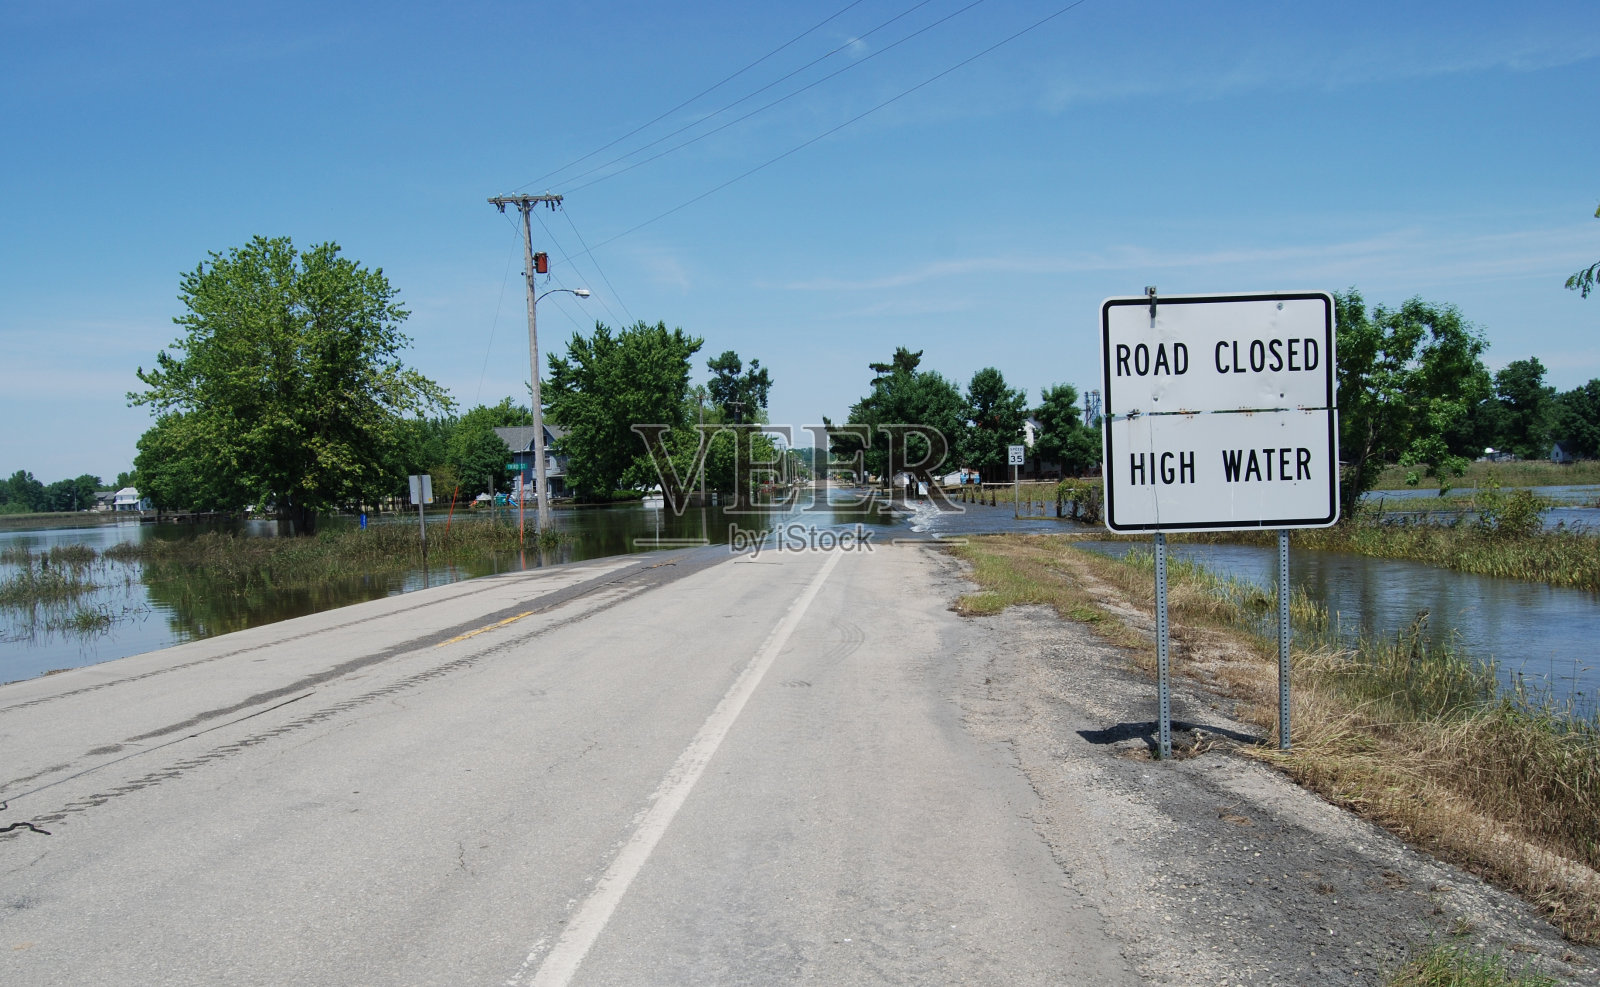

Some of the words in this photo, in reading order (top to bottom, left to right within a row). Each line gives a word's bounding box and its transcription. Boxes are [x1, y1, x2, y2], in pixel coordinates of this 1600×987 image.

[1116, 342, 1189, 377] ROAD
[1214, 338, 1319, 374] CLOSED
[1130, 450, 1195, 486] HIGH
[1221, 447, 1312, 483] WATER
